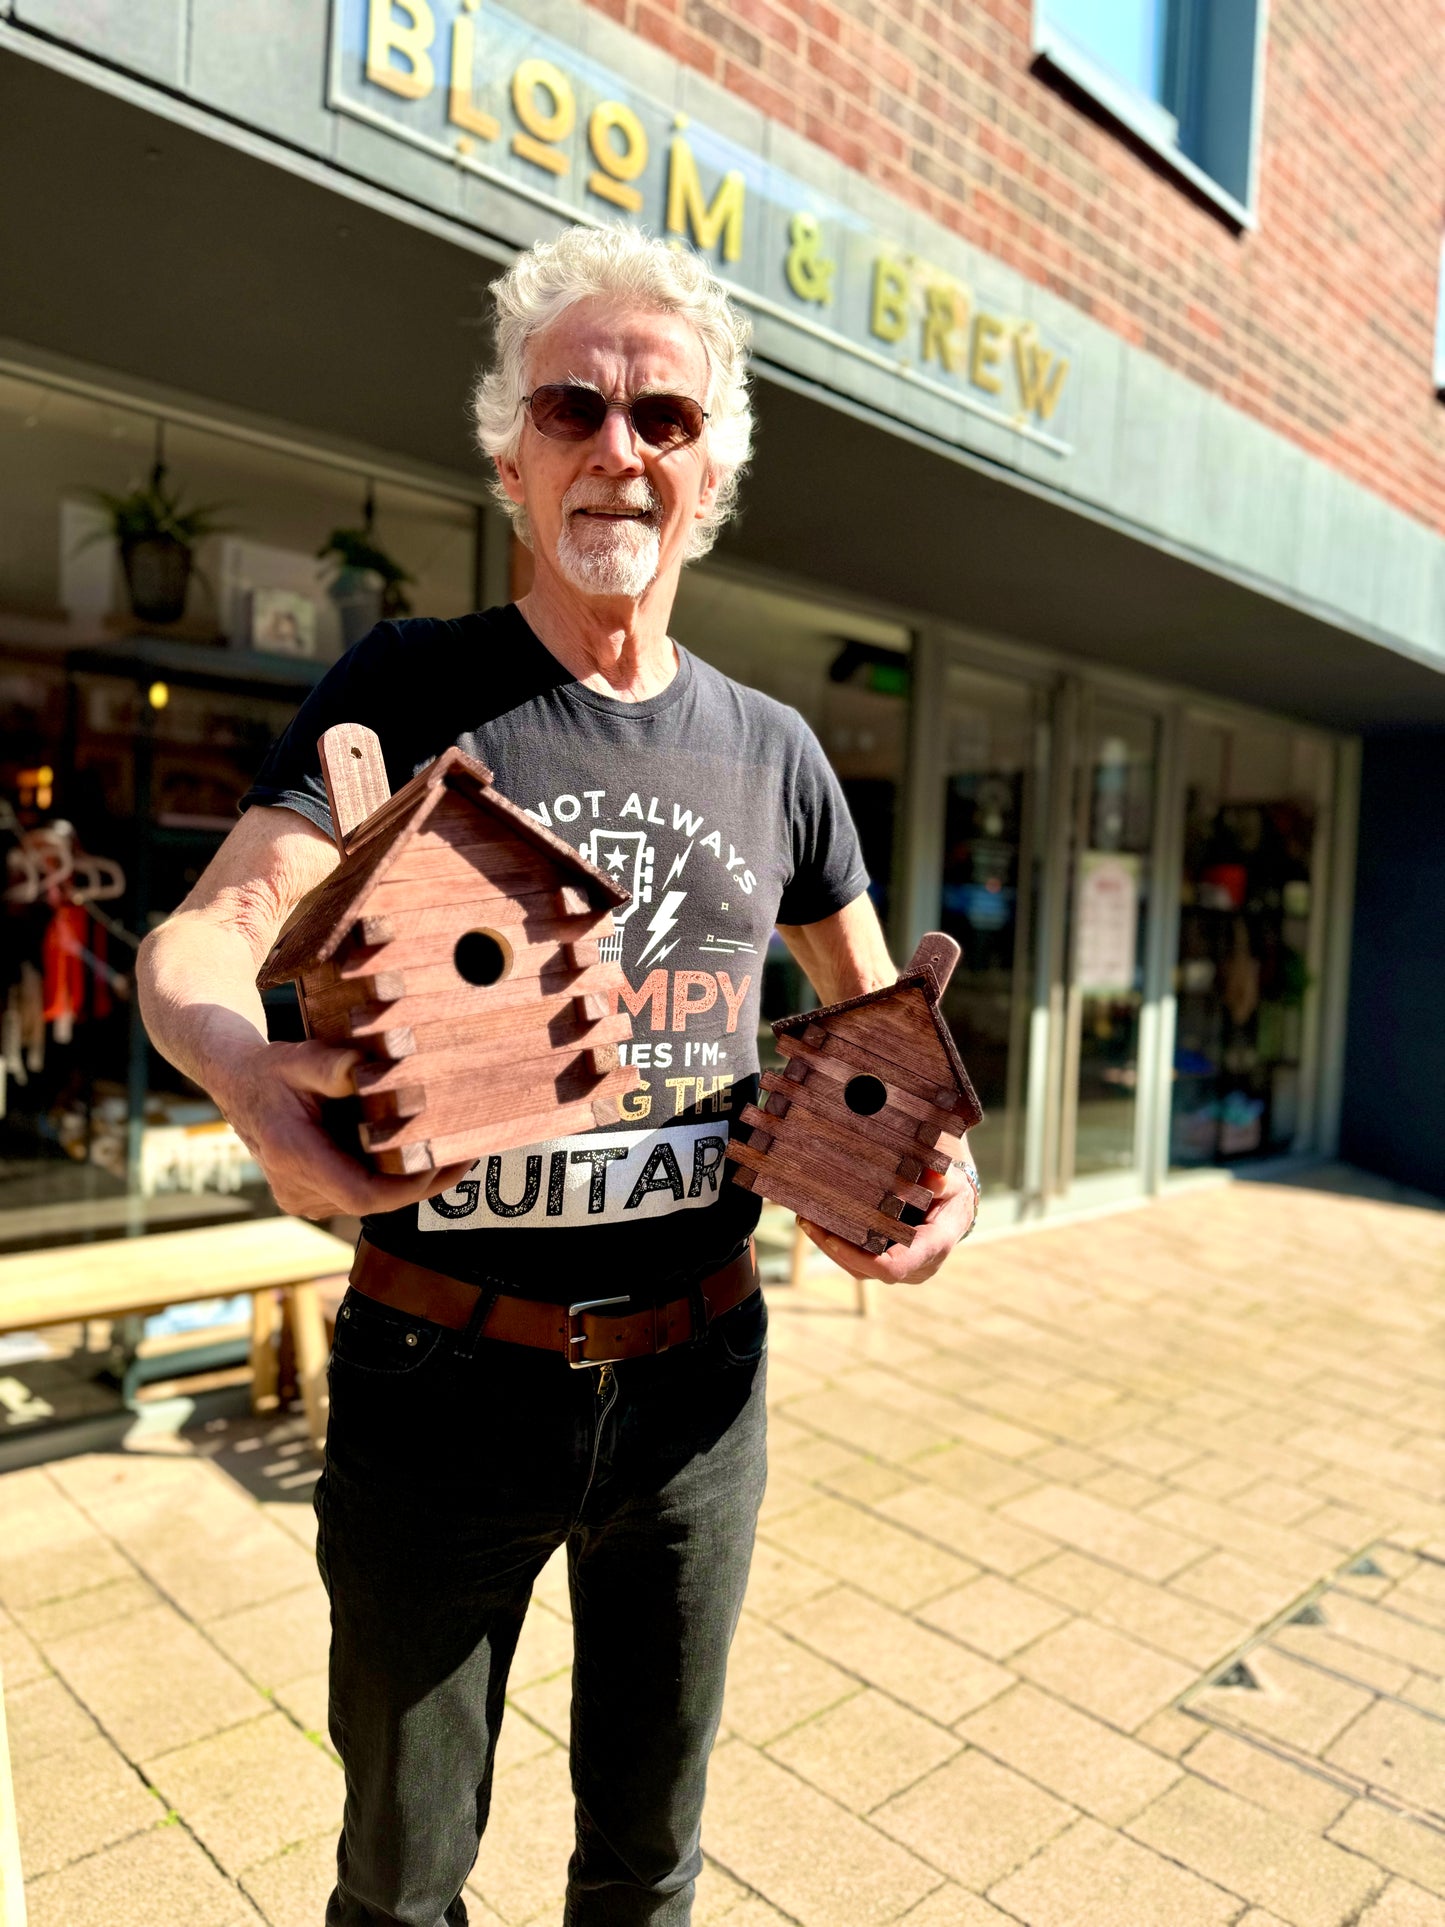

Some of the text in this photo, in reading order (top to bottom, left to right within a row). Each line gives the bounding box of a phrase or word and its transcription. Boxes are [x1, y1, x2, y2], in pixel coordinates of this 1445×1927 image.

[366, 0, 1070, 420] BLOOM & BREW
[619, 792, 757, 895] ALWAYS
[609, 968, 752, 1033] MPY
[665, 1073, 735, 1117] THE
[428, 1135, 727, 1220] GUITAR
